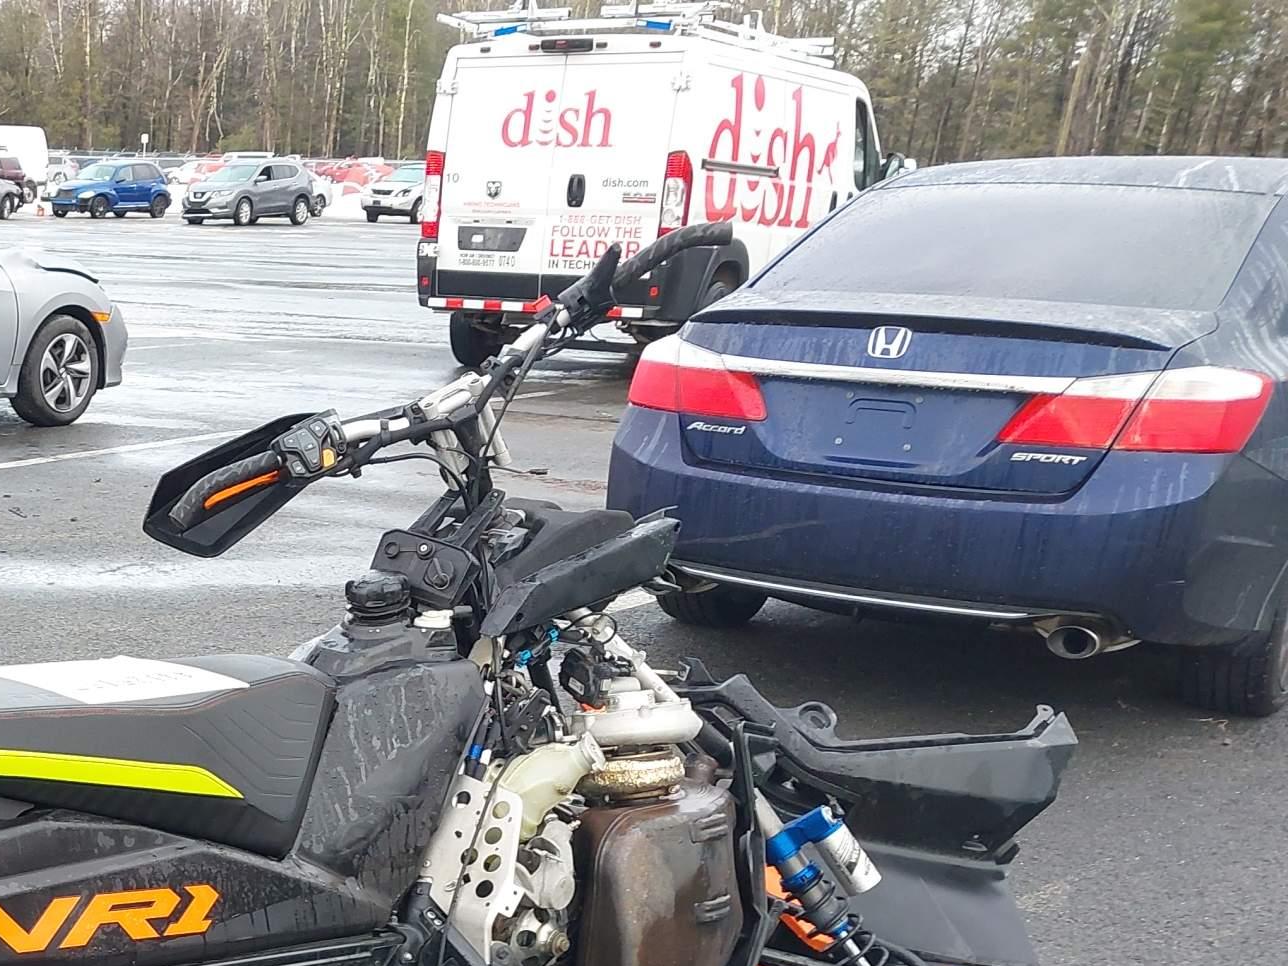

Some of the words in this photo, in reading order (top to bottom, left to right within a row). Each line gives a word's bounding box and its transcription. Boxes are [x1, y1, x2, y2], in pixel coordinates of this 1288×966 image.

[501, 89, 613, 148] dish
[704, 72, 814, 229] dish
[602, 177, 649, 188] dish.com
[551, 225, 611, 238] FOLLOW
[615, 226, 642, 239] THE
[549, 239, 641, 259] LEADR
[548, 259, 559, 269] IN
[687, 421, 746, 435] Accord
[1010, 452, 1088, 465] SPORT
